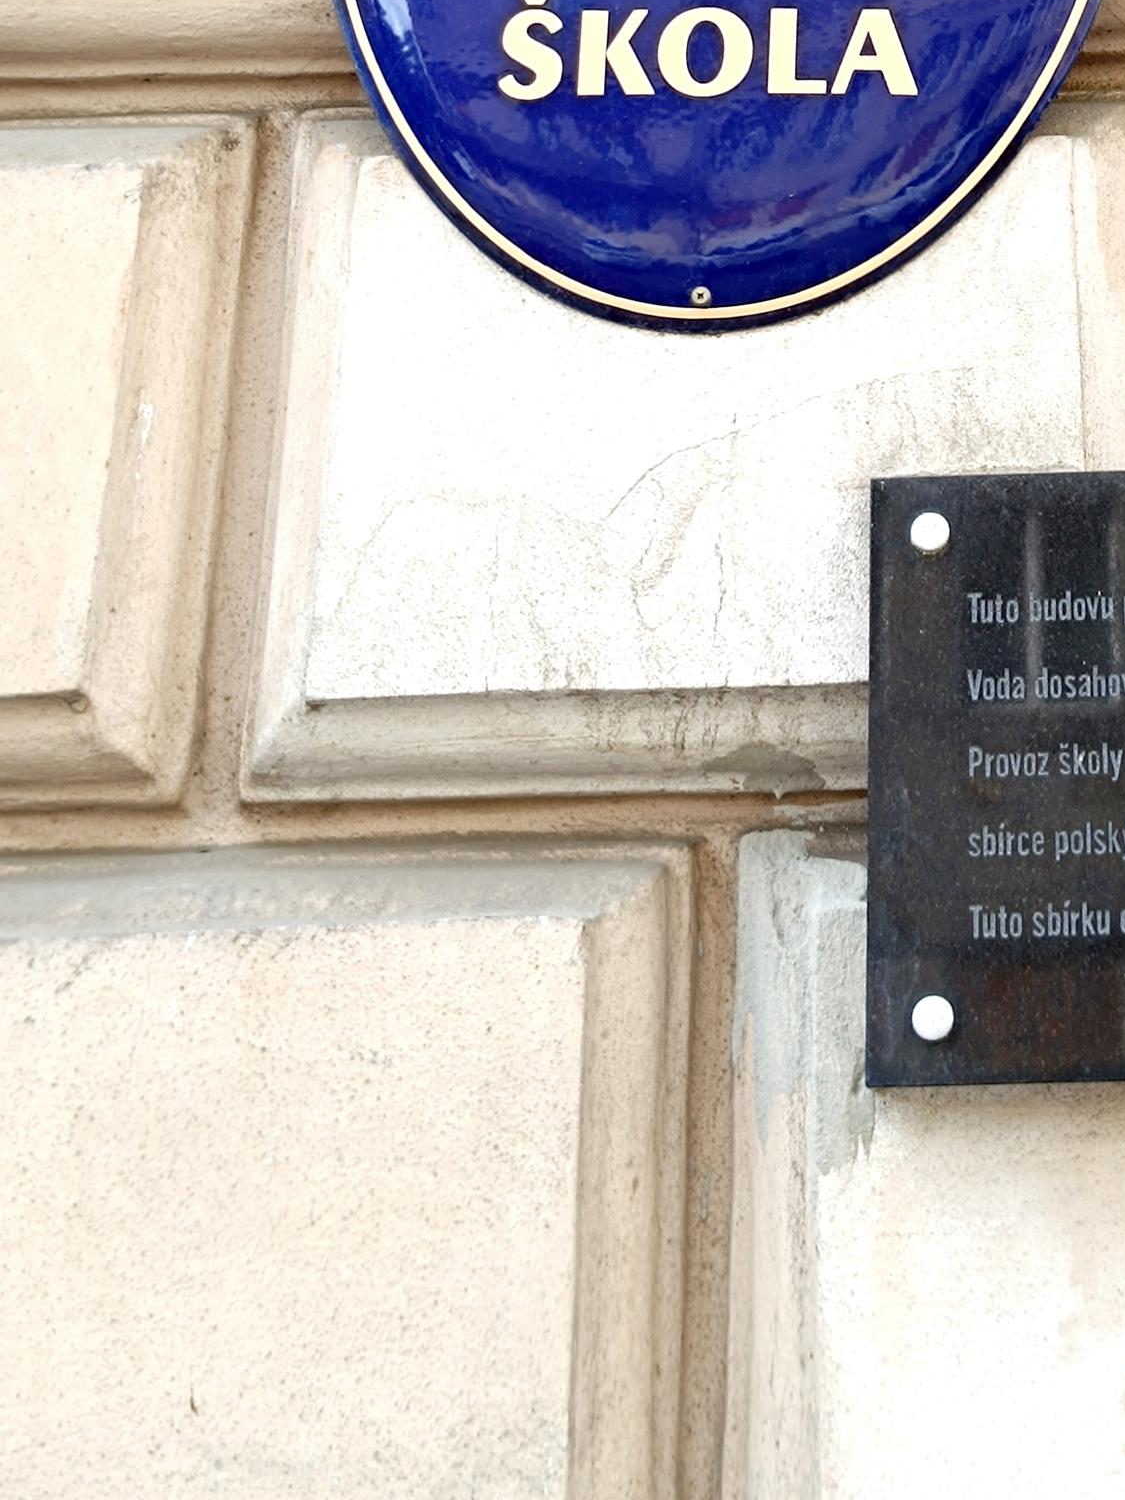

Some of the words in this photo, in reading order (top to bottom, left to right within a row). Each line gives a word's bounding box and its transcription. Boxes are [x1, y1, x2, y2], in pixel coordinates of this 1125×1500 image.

[966, 591, 1019, 623] Tuto
[1029, 590, 1114, 621] budovu
[967, 668, 1025, 701] Voda
[968, 746, 1049, 778] Provoz
[1059, 742, 1124, 781] školy
[968, 822, 1045, 857] sbírce
[969, 904, 1023, 939] Tuto
[1032, 900, 1110, 937] sbírku
